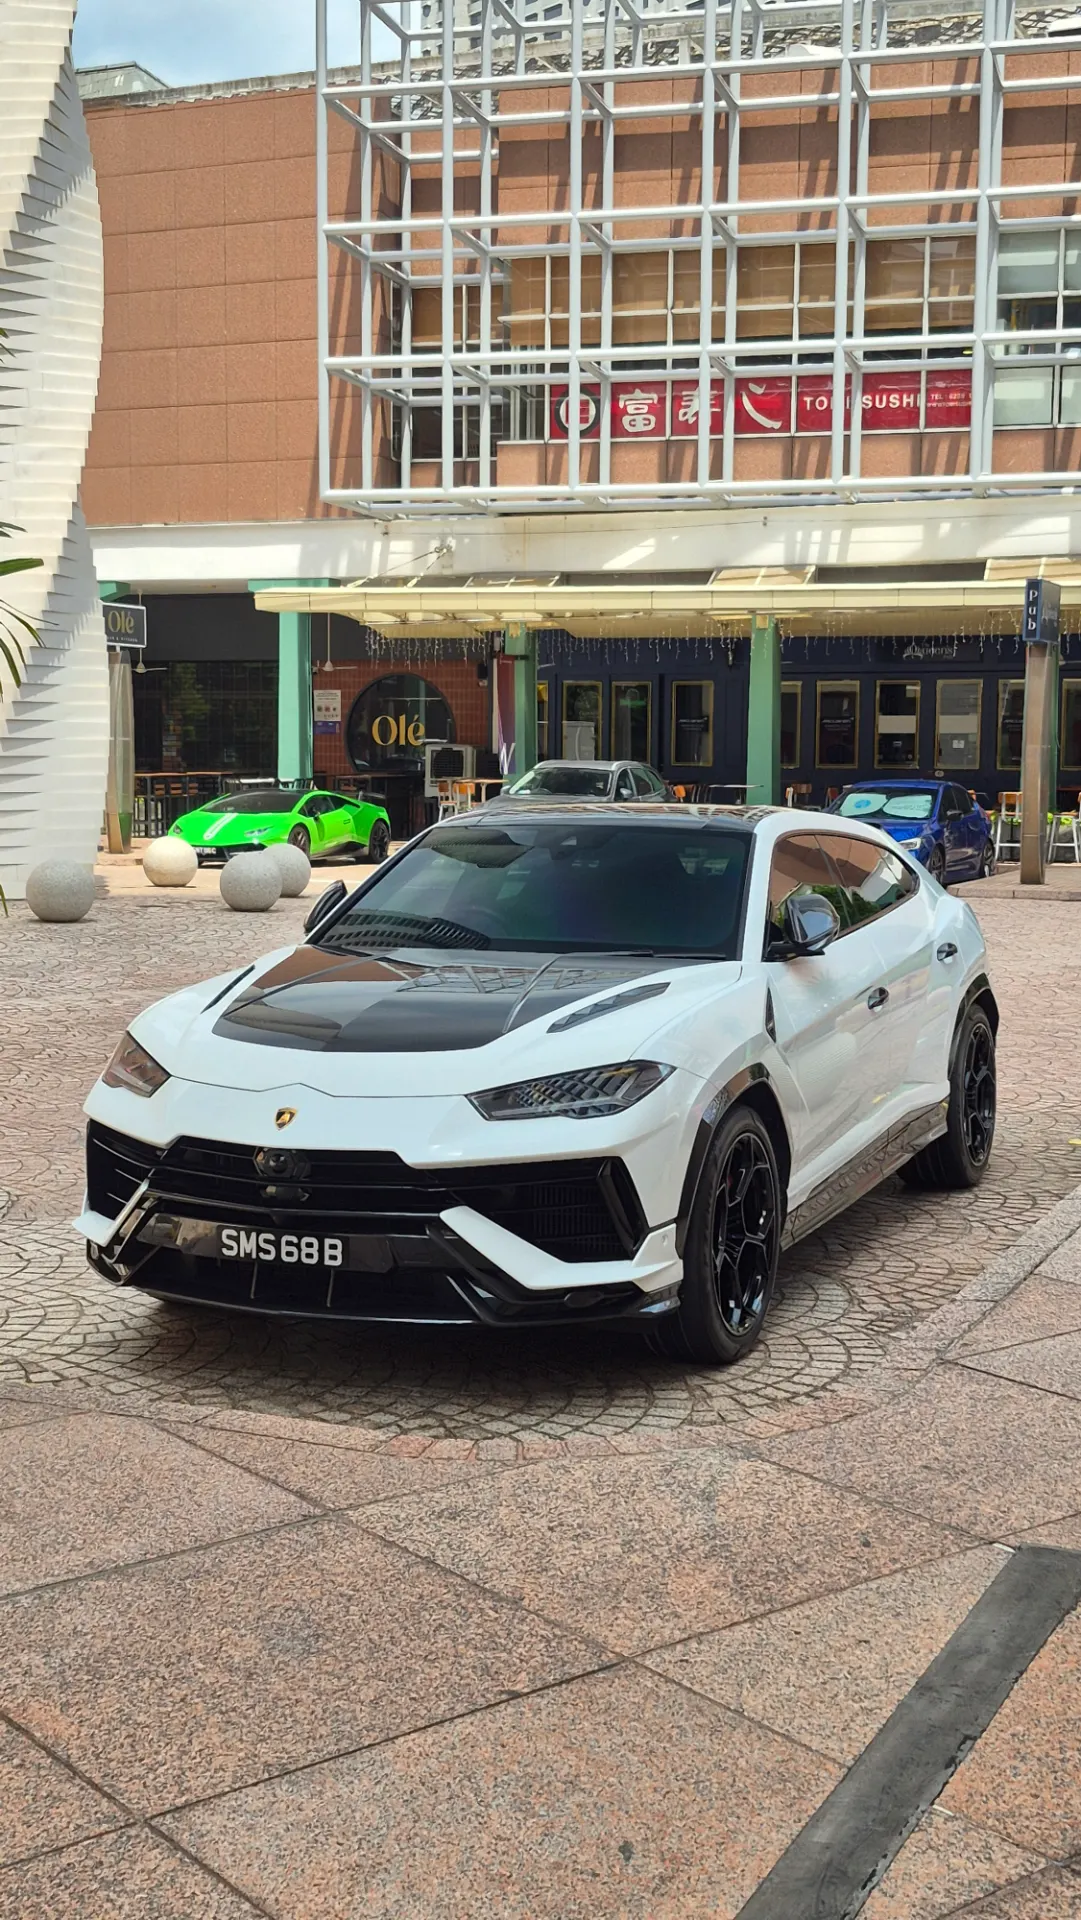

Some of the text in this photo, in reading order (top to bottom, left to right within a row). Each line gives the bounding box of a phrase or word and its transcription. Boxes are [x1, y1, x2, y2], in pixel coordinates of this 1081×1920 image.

[803, 396, 850, 411] TOI
[108, 610, 135, 634] Olé
[371, 714, 426, 746] Olé
